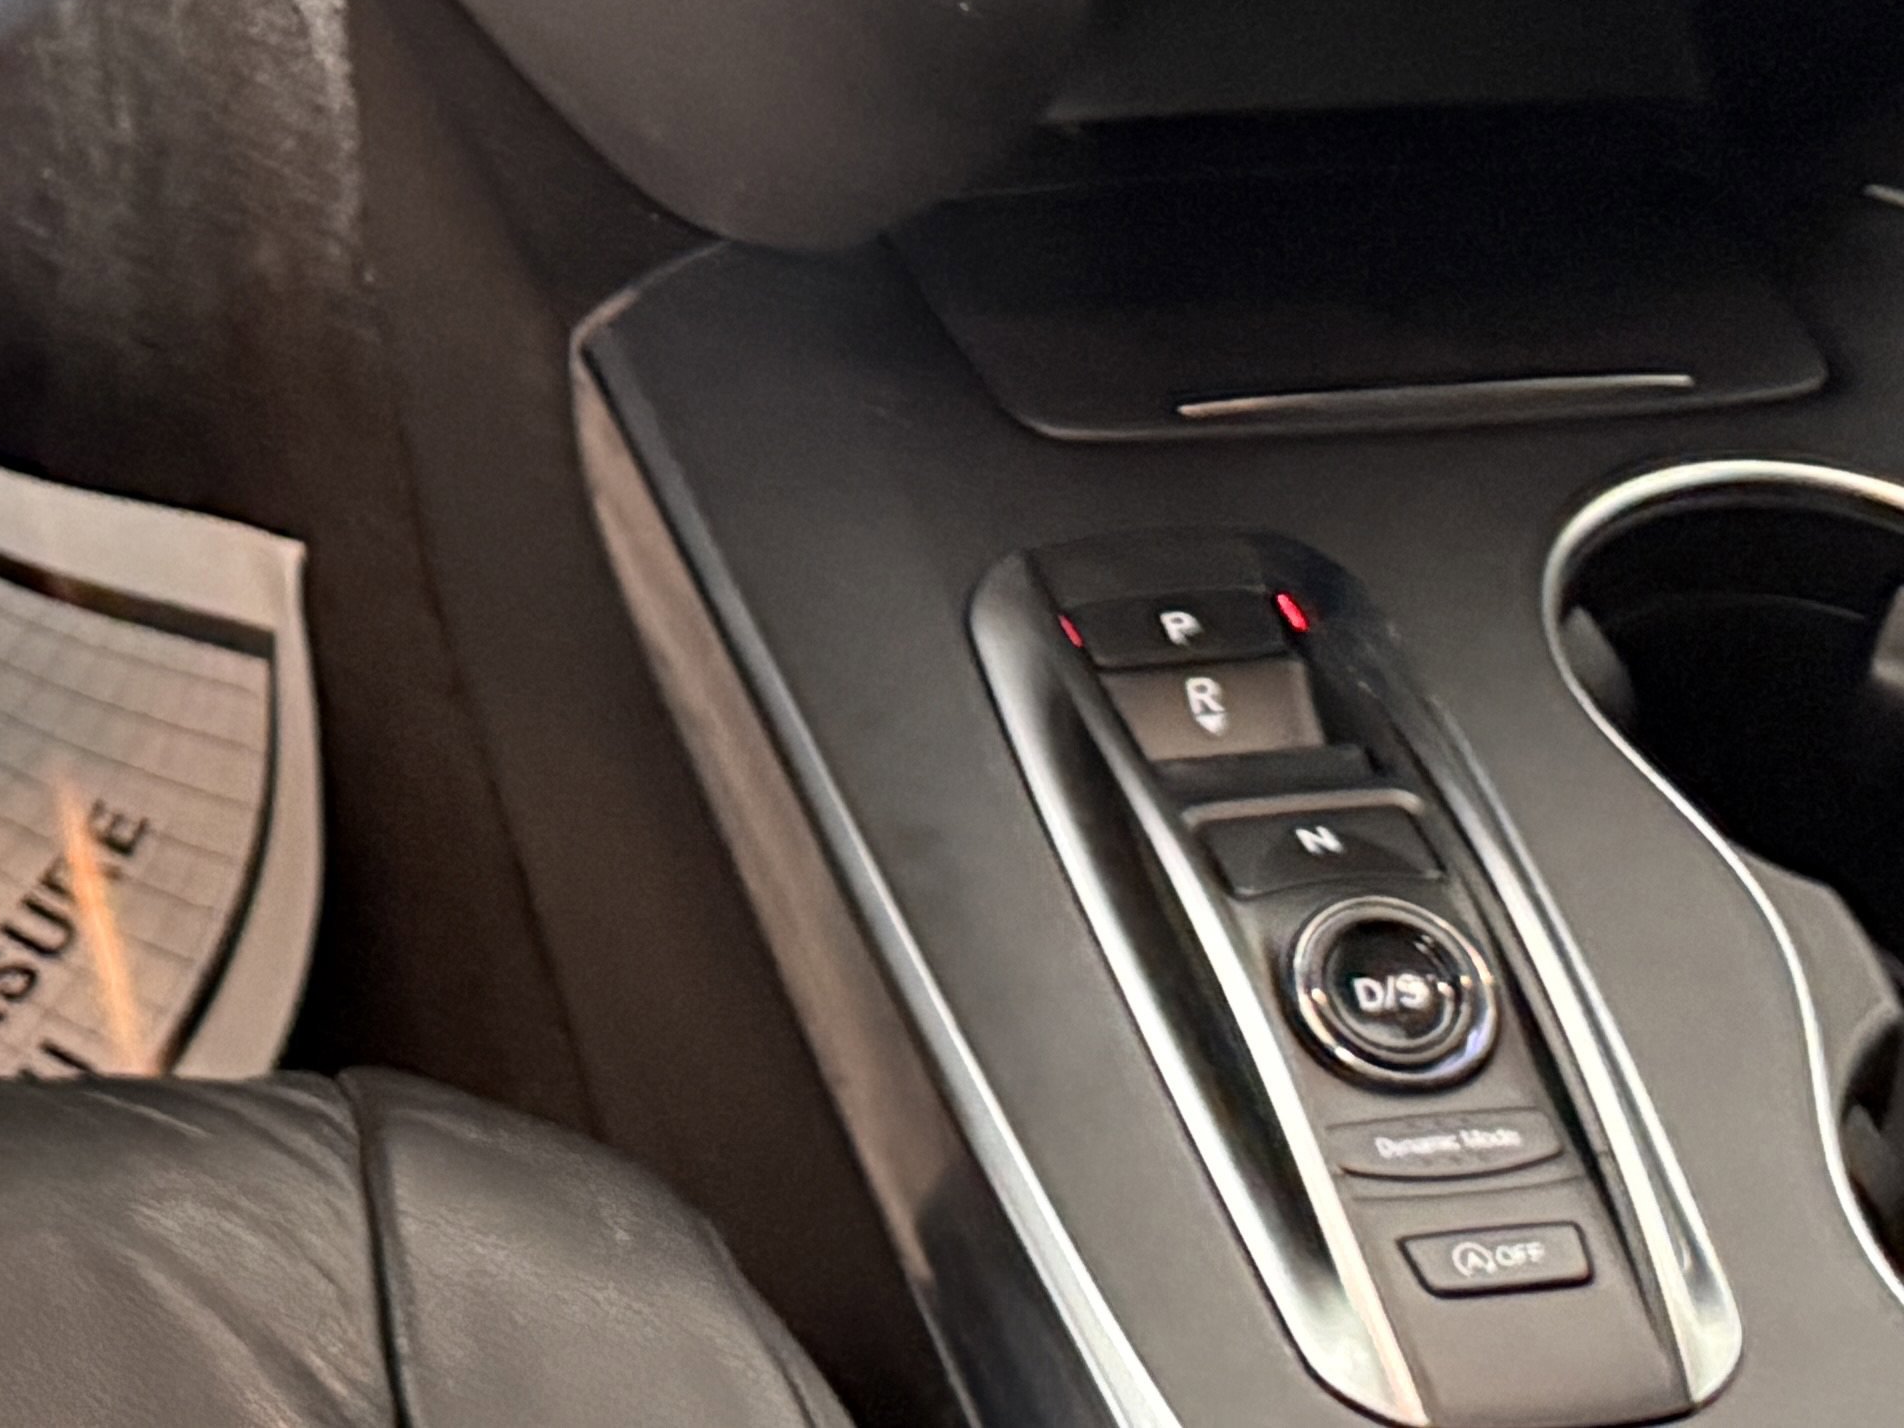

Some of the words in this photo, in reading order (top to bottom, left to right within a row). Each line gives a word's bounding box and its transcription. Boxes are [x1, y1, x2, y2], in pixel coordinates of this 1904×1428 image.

[1158, 611, 1203, 647] P
[1185, 677, 1225, 717] R
[1295, 826, 1346, 857] N
[1353, 972, 1433, 1013] D/S
[1459, 1128, 1524, 1151] Mode
[1495, 1240, 1549, 1268] OFF
